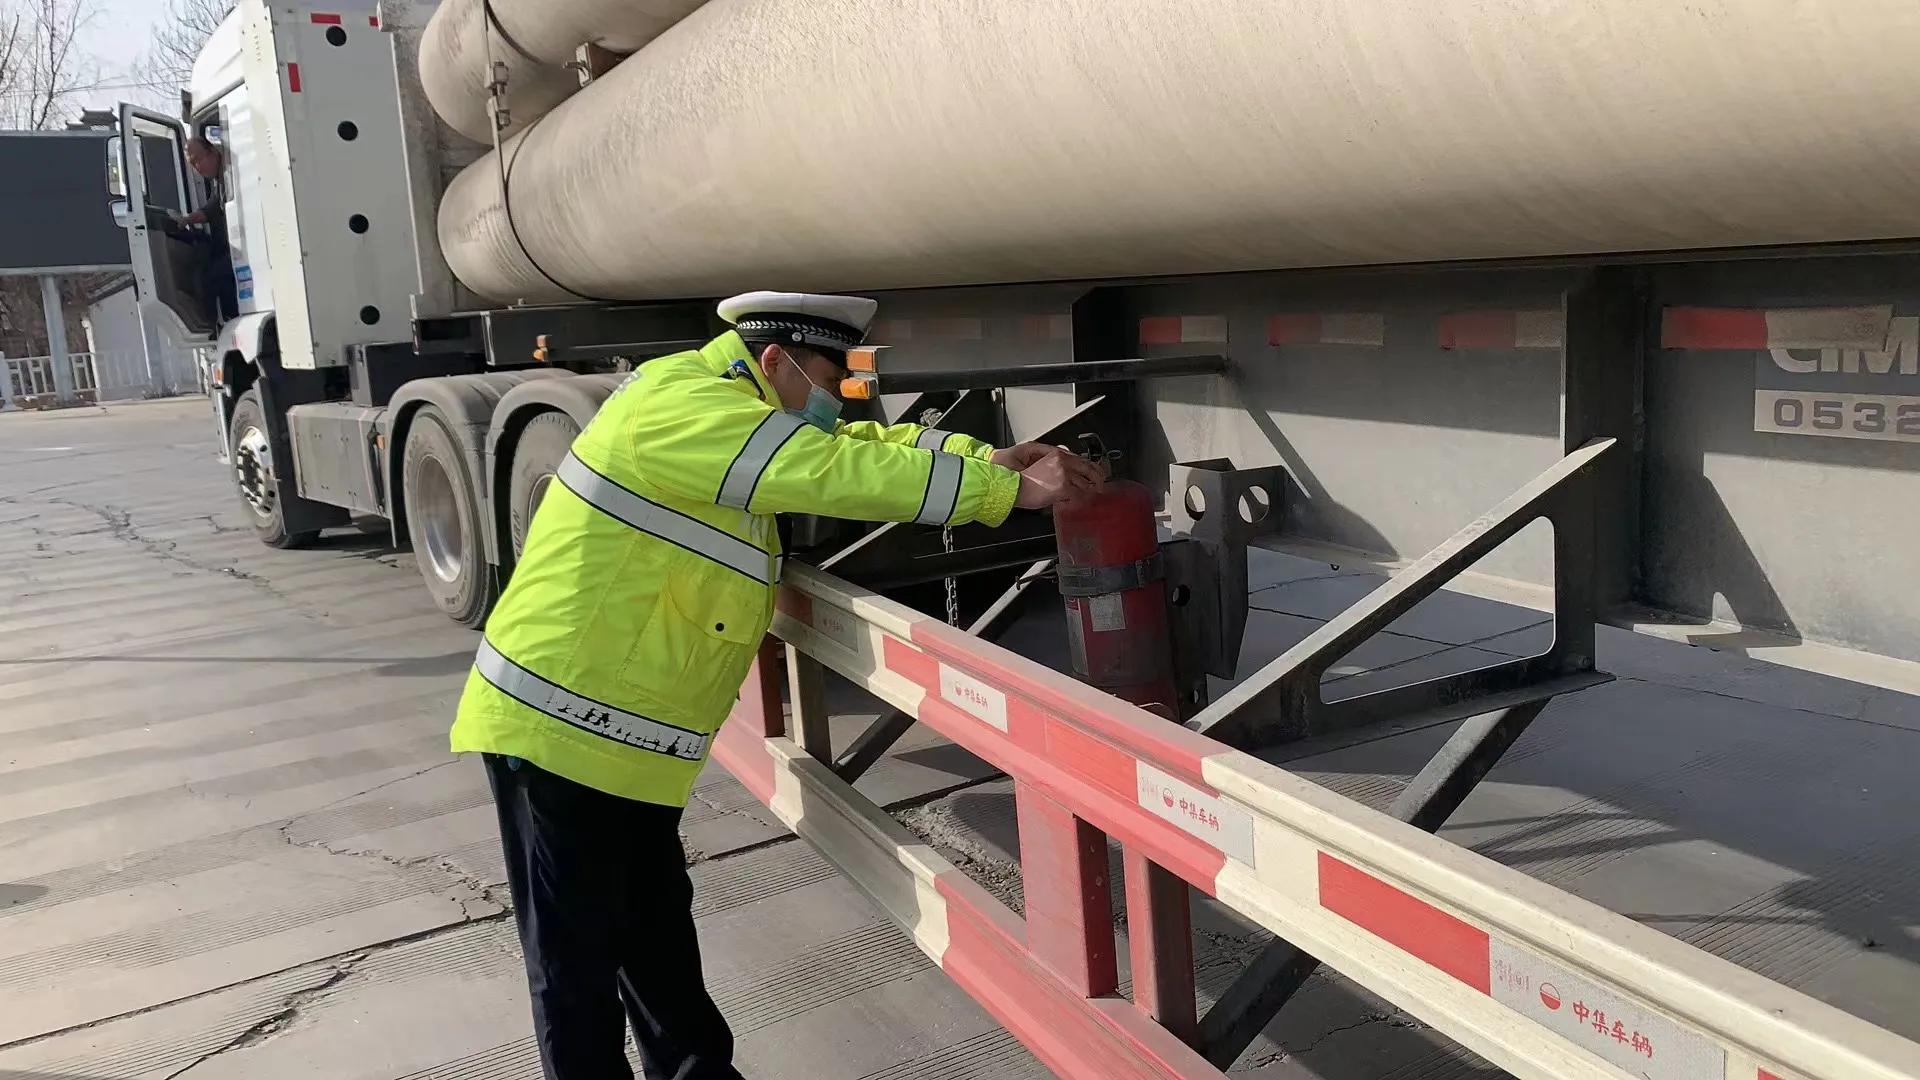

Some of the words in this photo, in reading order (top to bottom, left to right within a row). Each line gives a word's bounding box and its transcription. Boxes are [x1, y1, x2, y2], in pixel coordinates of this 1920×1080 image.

[1179, 797, 1219, 831] 中集车辆
[1572, 1000, 1654, 1058] 中集车辆
